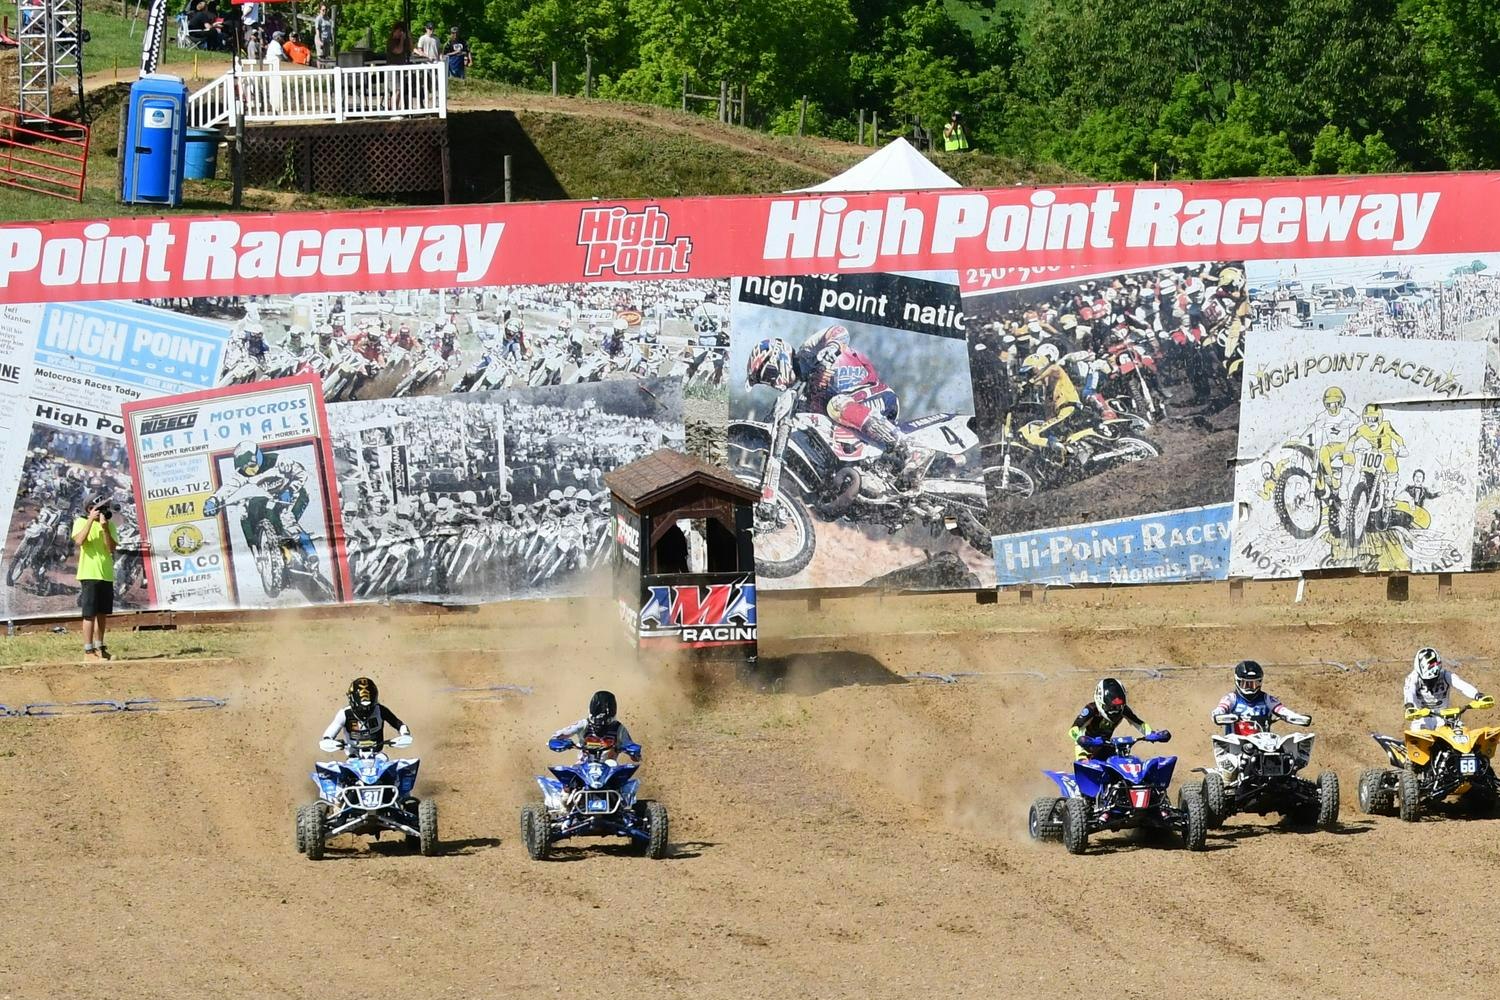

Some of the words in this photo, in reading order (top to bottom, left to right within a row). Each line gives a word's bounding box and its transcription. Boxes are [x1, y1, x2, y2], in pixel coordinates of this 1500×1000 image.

[577, 206, 669, 247] High
[762, 197, 924, 269] High
[930, 190, 1120, 254] Point
[1126, 187, 1441, 252] Raceway
[0, 222, 175, 288] Point
[182, 220, 505, 283] Raceway
[584, 236, 692, 277] Point
[819, 287, 889, 317] point
[45, 308, 129, 362] HIGH
[131, 327, 216, 370] POINT
[35, 367, 82, 386] Motocross
[84, 378, 112, 393] Races
[114, 384, 142, 400] Today
[1248, 361, 1299, 399] HIGH
[1303, 352, 1370, 378] POINT
[35, 404, 88, 430] High
[210, 398, 307, 423] MOTOCROSS
[140, 413, 198, 436] WISECO
[142, 412, 309, 451] NATIONALS
[262, 433, 274, 441] MT.
[940, 425, 967, 450] 4
[143, 448, 177, 460] HIGHPOINT
[179, 444, 210, 454] RACEWAY
[1363, 453, 1383, 469] 100
[147, 486, 180, 499] KDKA
[202, 481, 210, 491] 2
[166, 501, 196, 516] AMA
[159, 554, 220, 576] BRACO
[172, 573, 212, 586] TRAILERS
[640, 583, 757, 629] AMA
[1460, 759, 1476, 773] 68
[364, 791, 380, 804] 31
[592, 801, 603, 809] 4
[1135, 791, 1146, 808] 1
